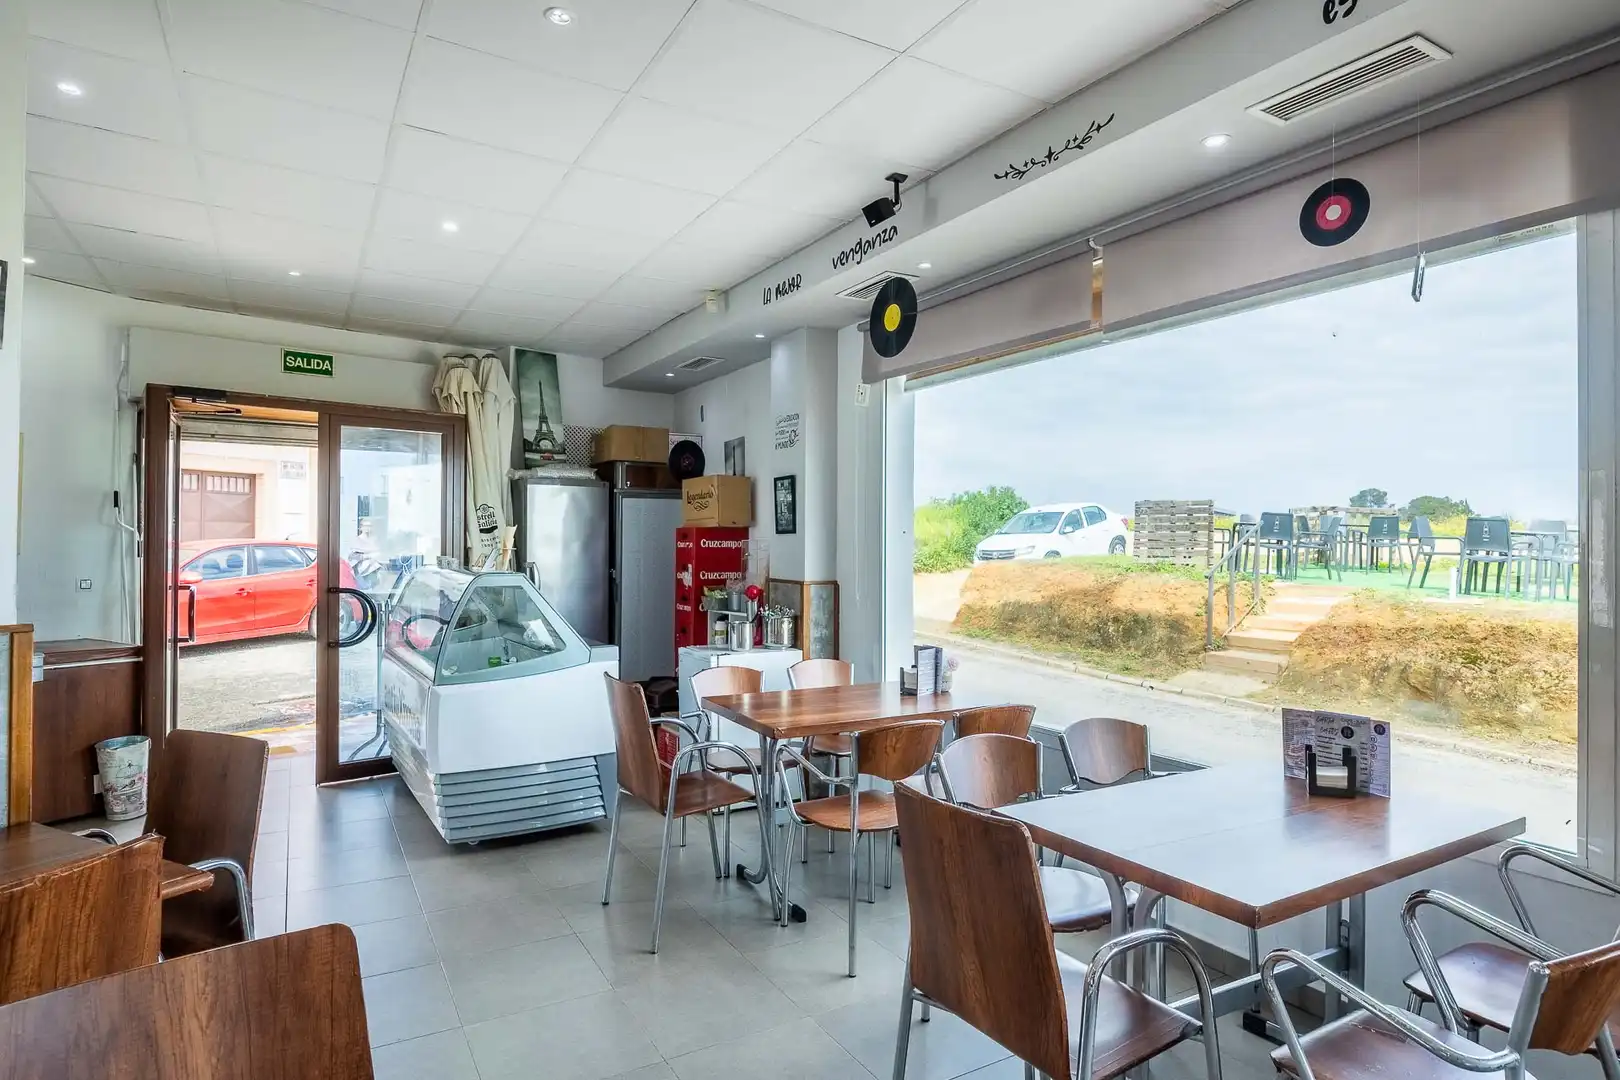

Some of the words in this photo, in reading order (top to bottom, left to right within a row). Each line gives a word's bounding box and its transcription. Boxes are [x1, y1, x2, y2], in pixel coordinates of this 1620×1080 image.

[763, 287, 773, 306] LA
[832, 225, 898, 270] venganza
[286, 356, 332, 371] SALIDA
[477, 511, 495, 520] strell
[700, 539, 742, 549] Cruzcampo
[699, 571, 742, 580] Cruzcampo
